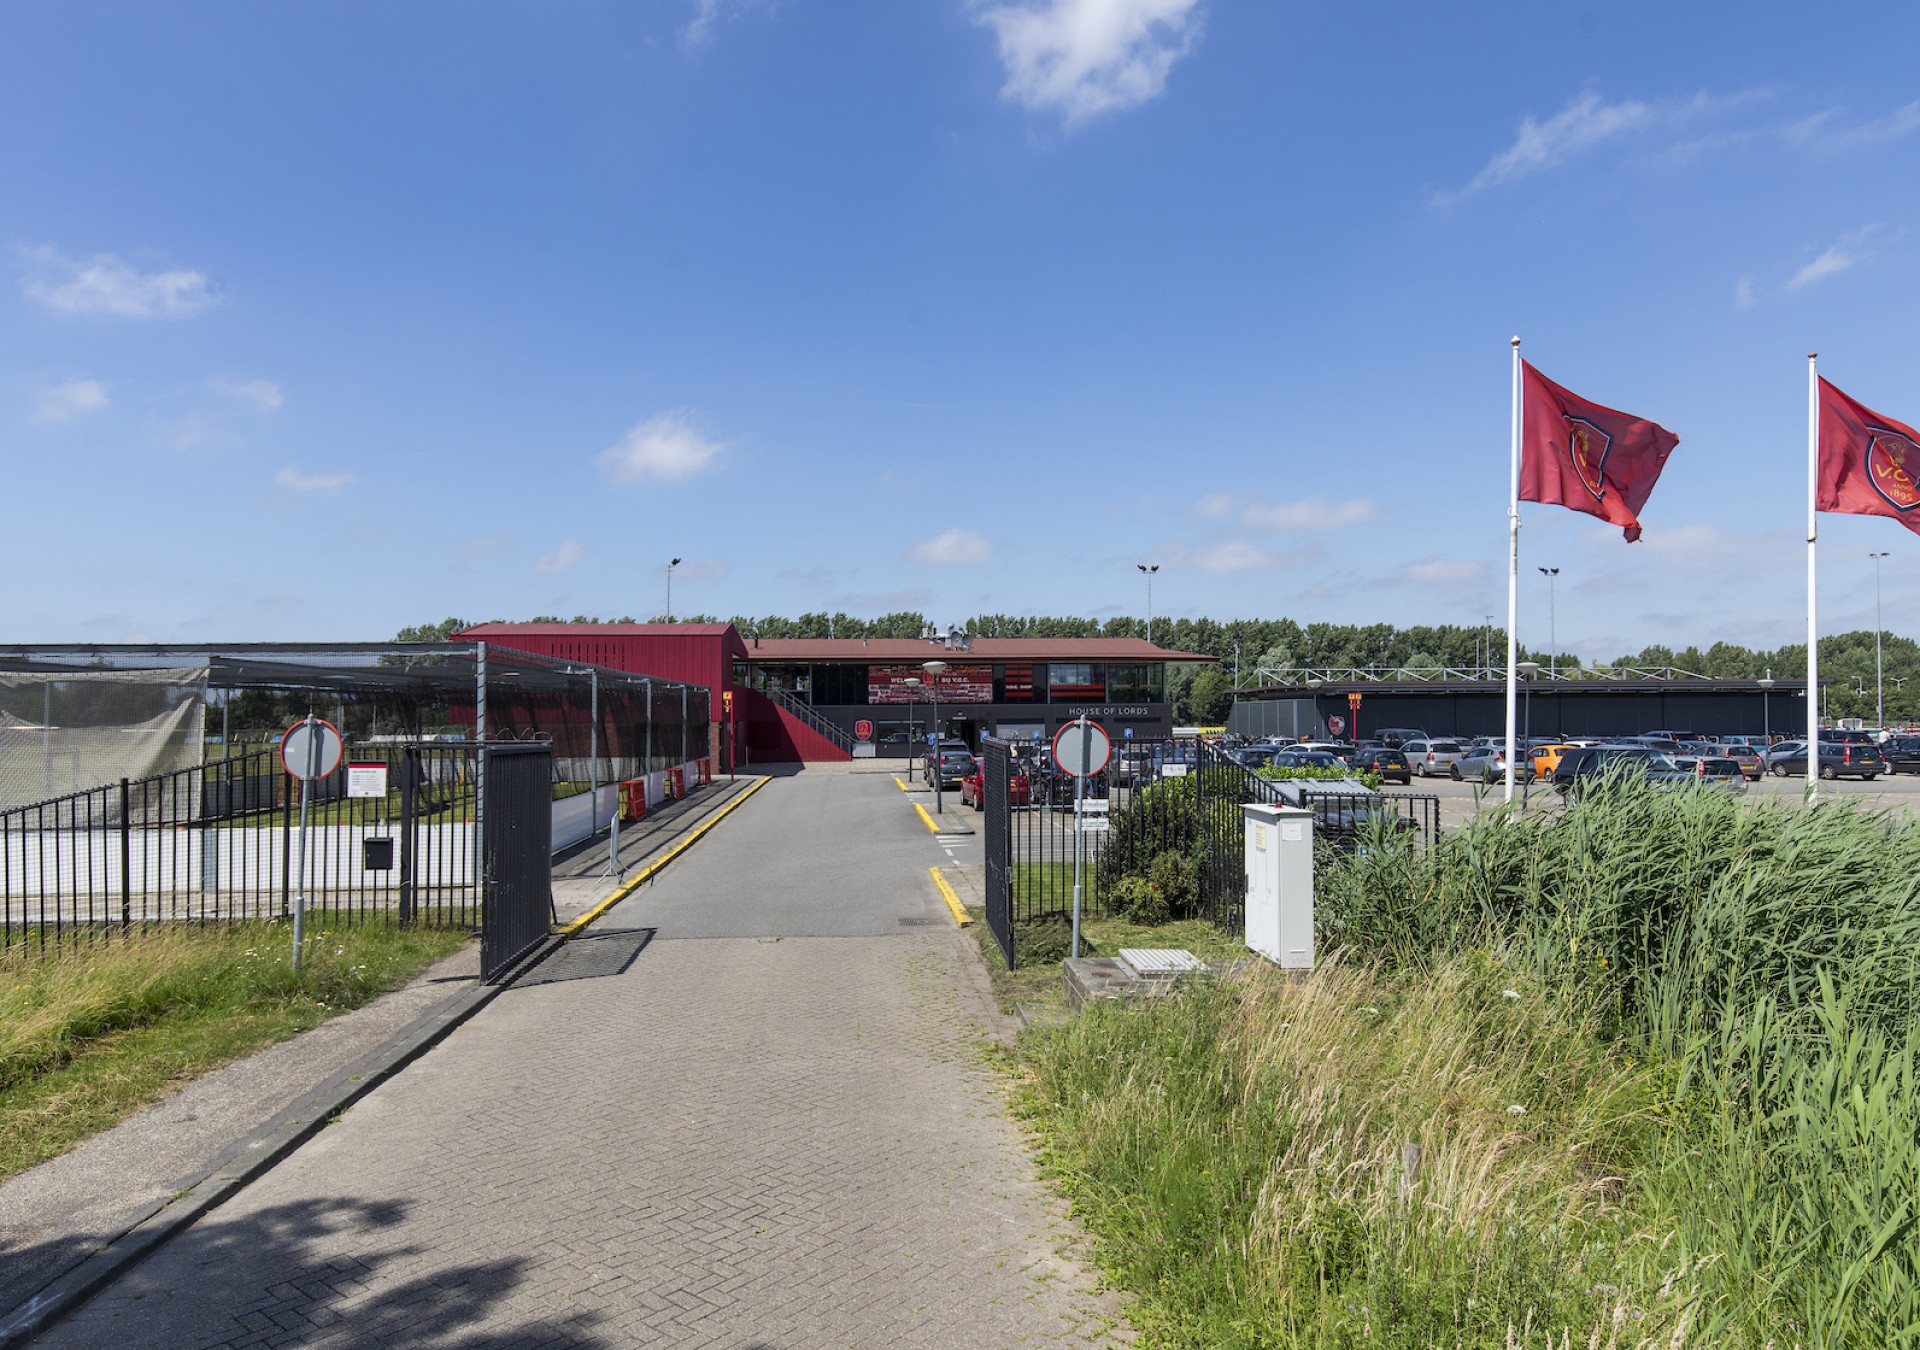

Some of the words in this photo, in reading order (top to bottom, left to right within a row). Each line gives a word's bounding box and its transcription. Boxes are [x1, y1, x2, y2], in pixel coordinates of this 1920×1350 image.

[1892, 482, 1912, 491] ANNO
[1889, 488, 1913, 502] 1895
[1069, 707, 1100, 715] HOUSE
[1103, 707, 1116, 715] OF
[1118, 707, 1148, 715] LORDS
